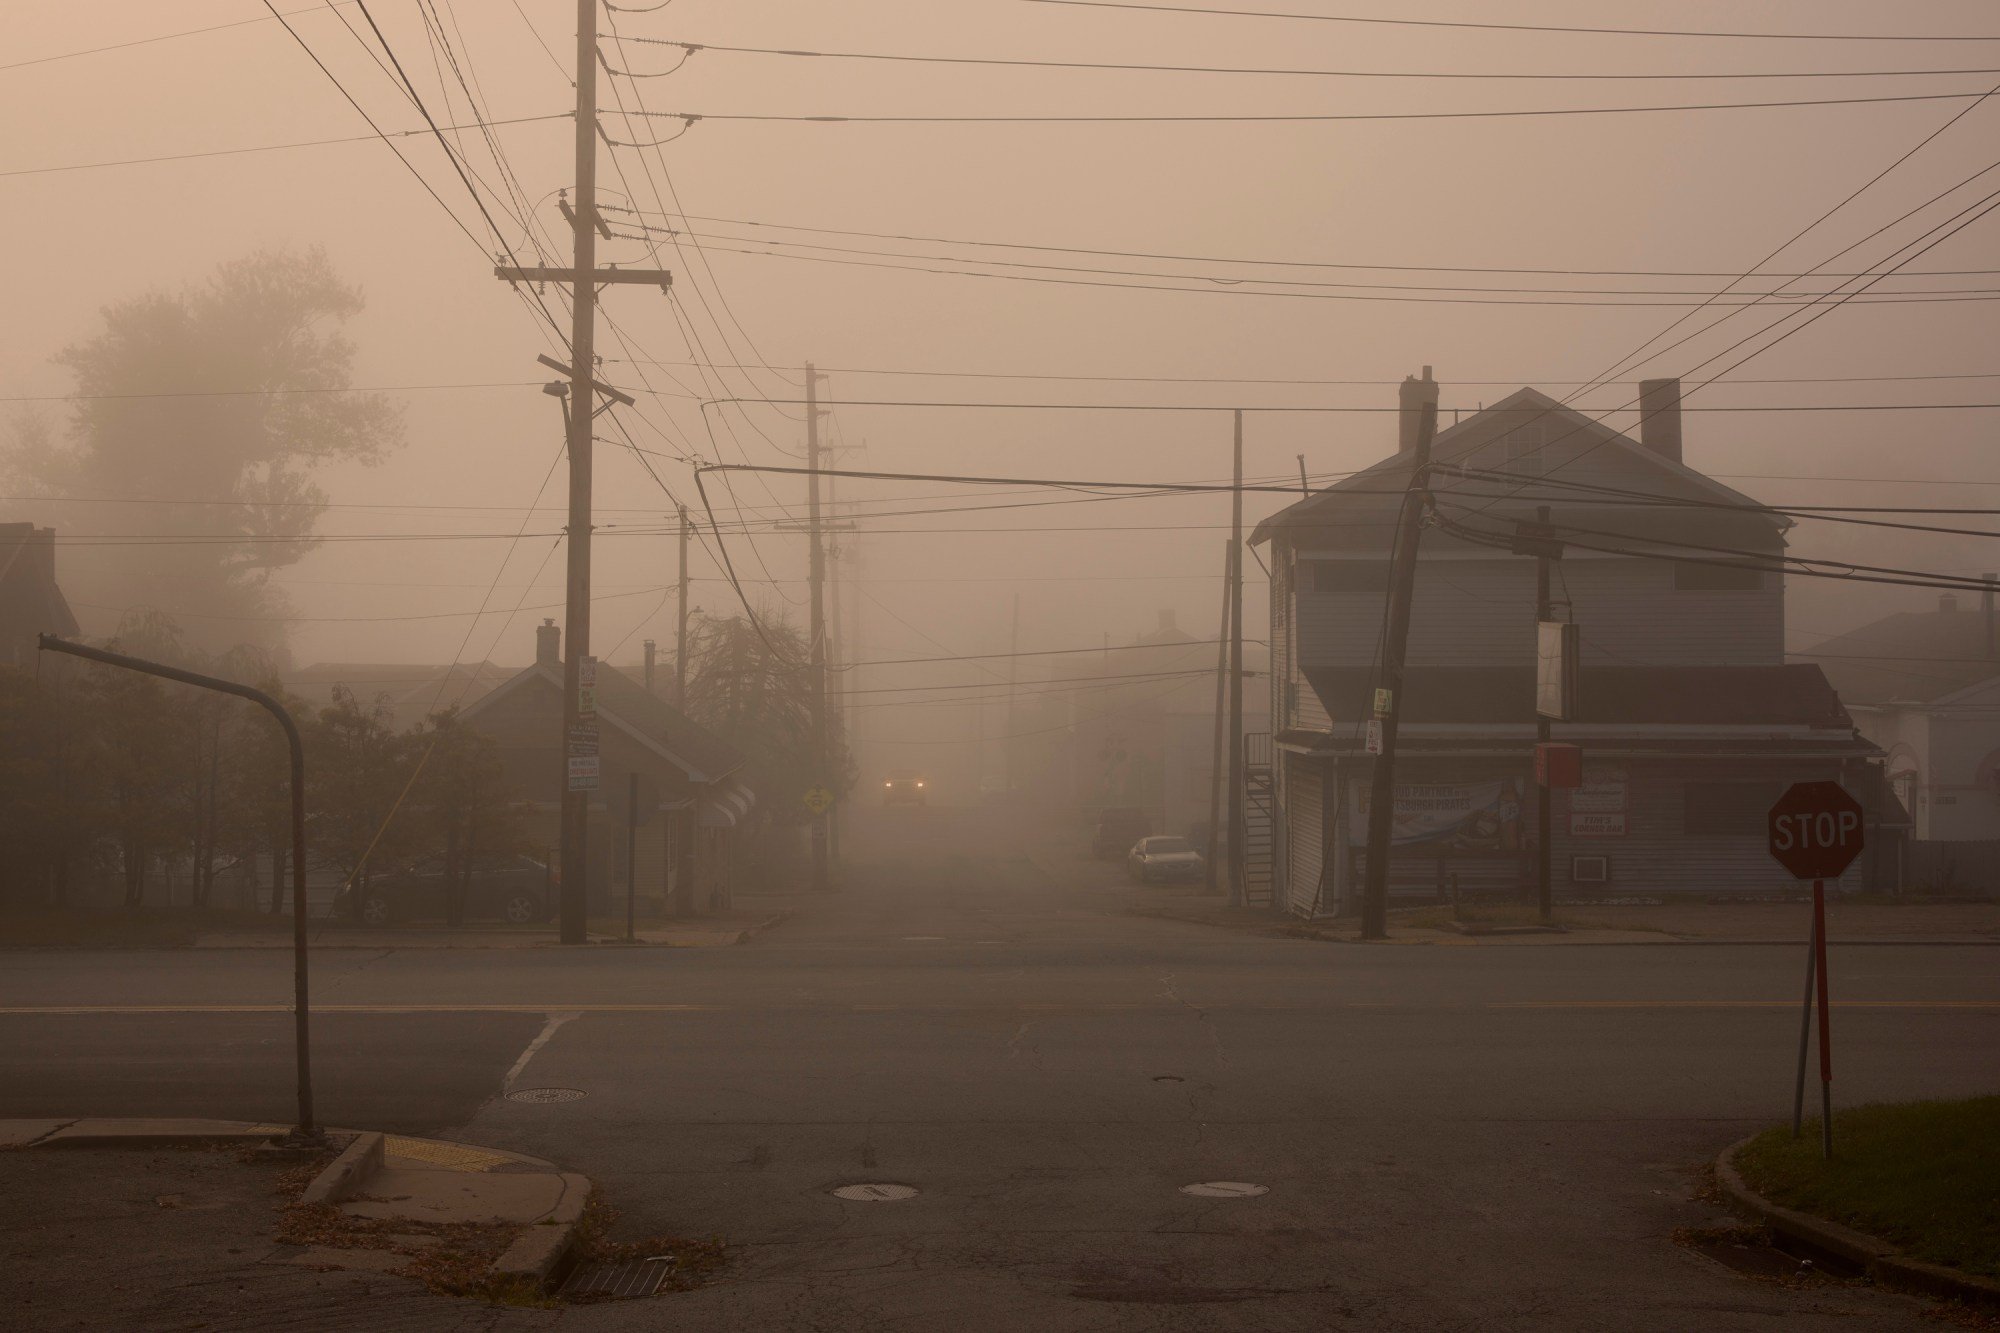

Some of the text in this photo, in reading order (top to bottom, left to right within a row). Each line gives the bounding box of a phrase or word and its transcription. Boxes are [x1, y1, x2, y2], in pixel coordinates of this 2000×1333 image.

[1392, 785, 1410, 797] OUD
[1413, 785, 1454, 797] PARTNER
[1392, 798, 1471, 811] TSBURGH PIRATES
[1583, 816, 1612, 824] TIM'S
[1574, 824, 1623, 832] CORNER BAR
[1774, 810, 1858, 851] STOP
